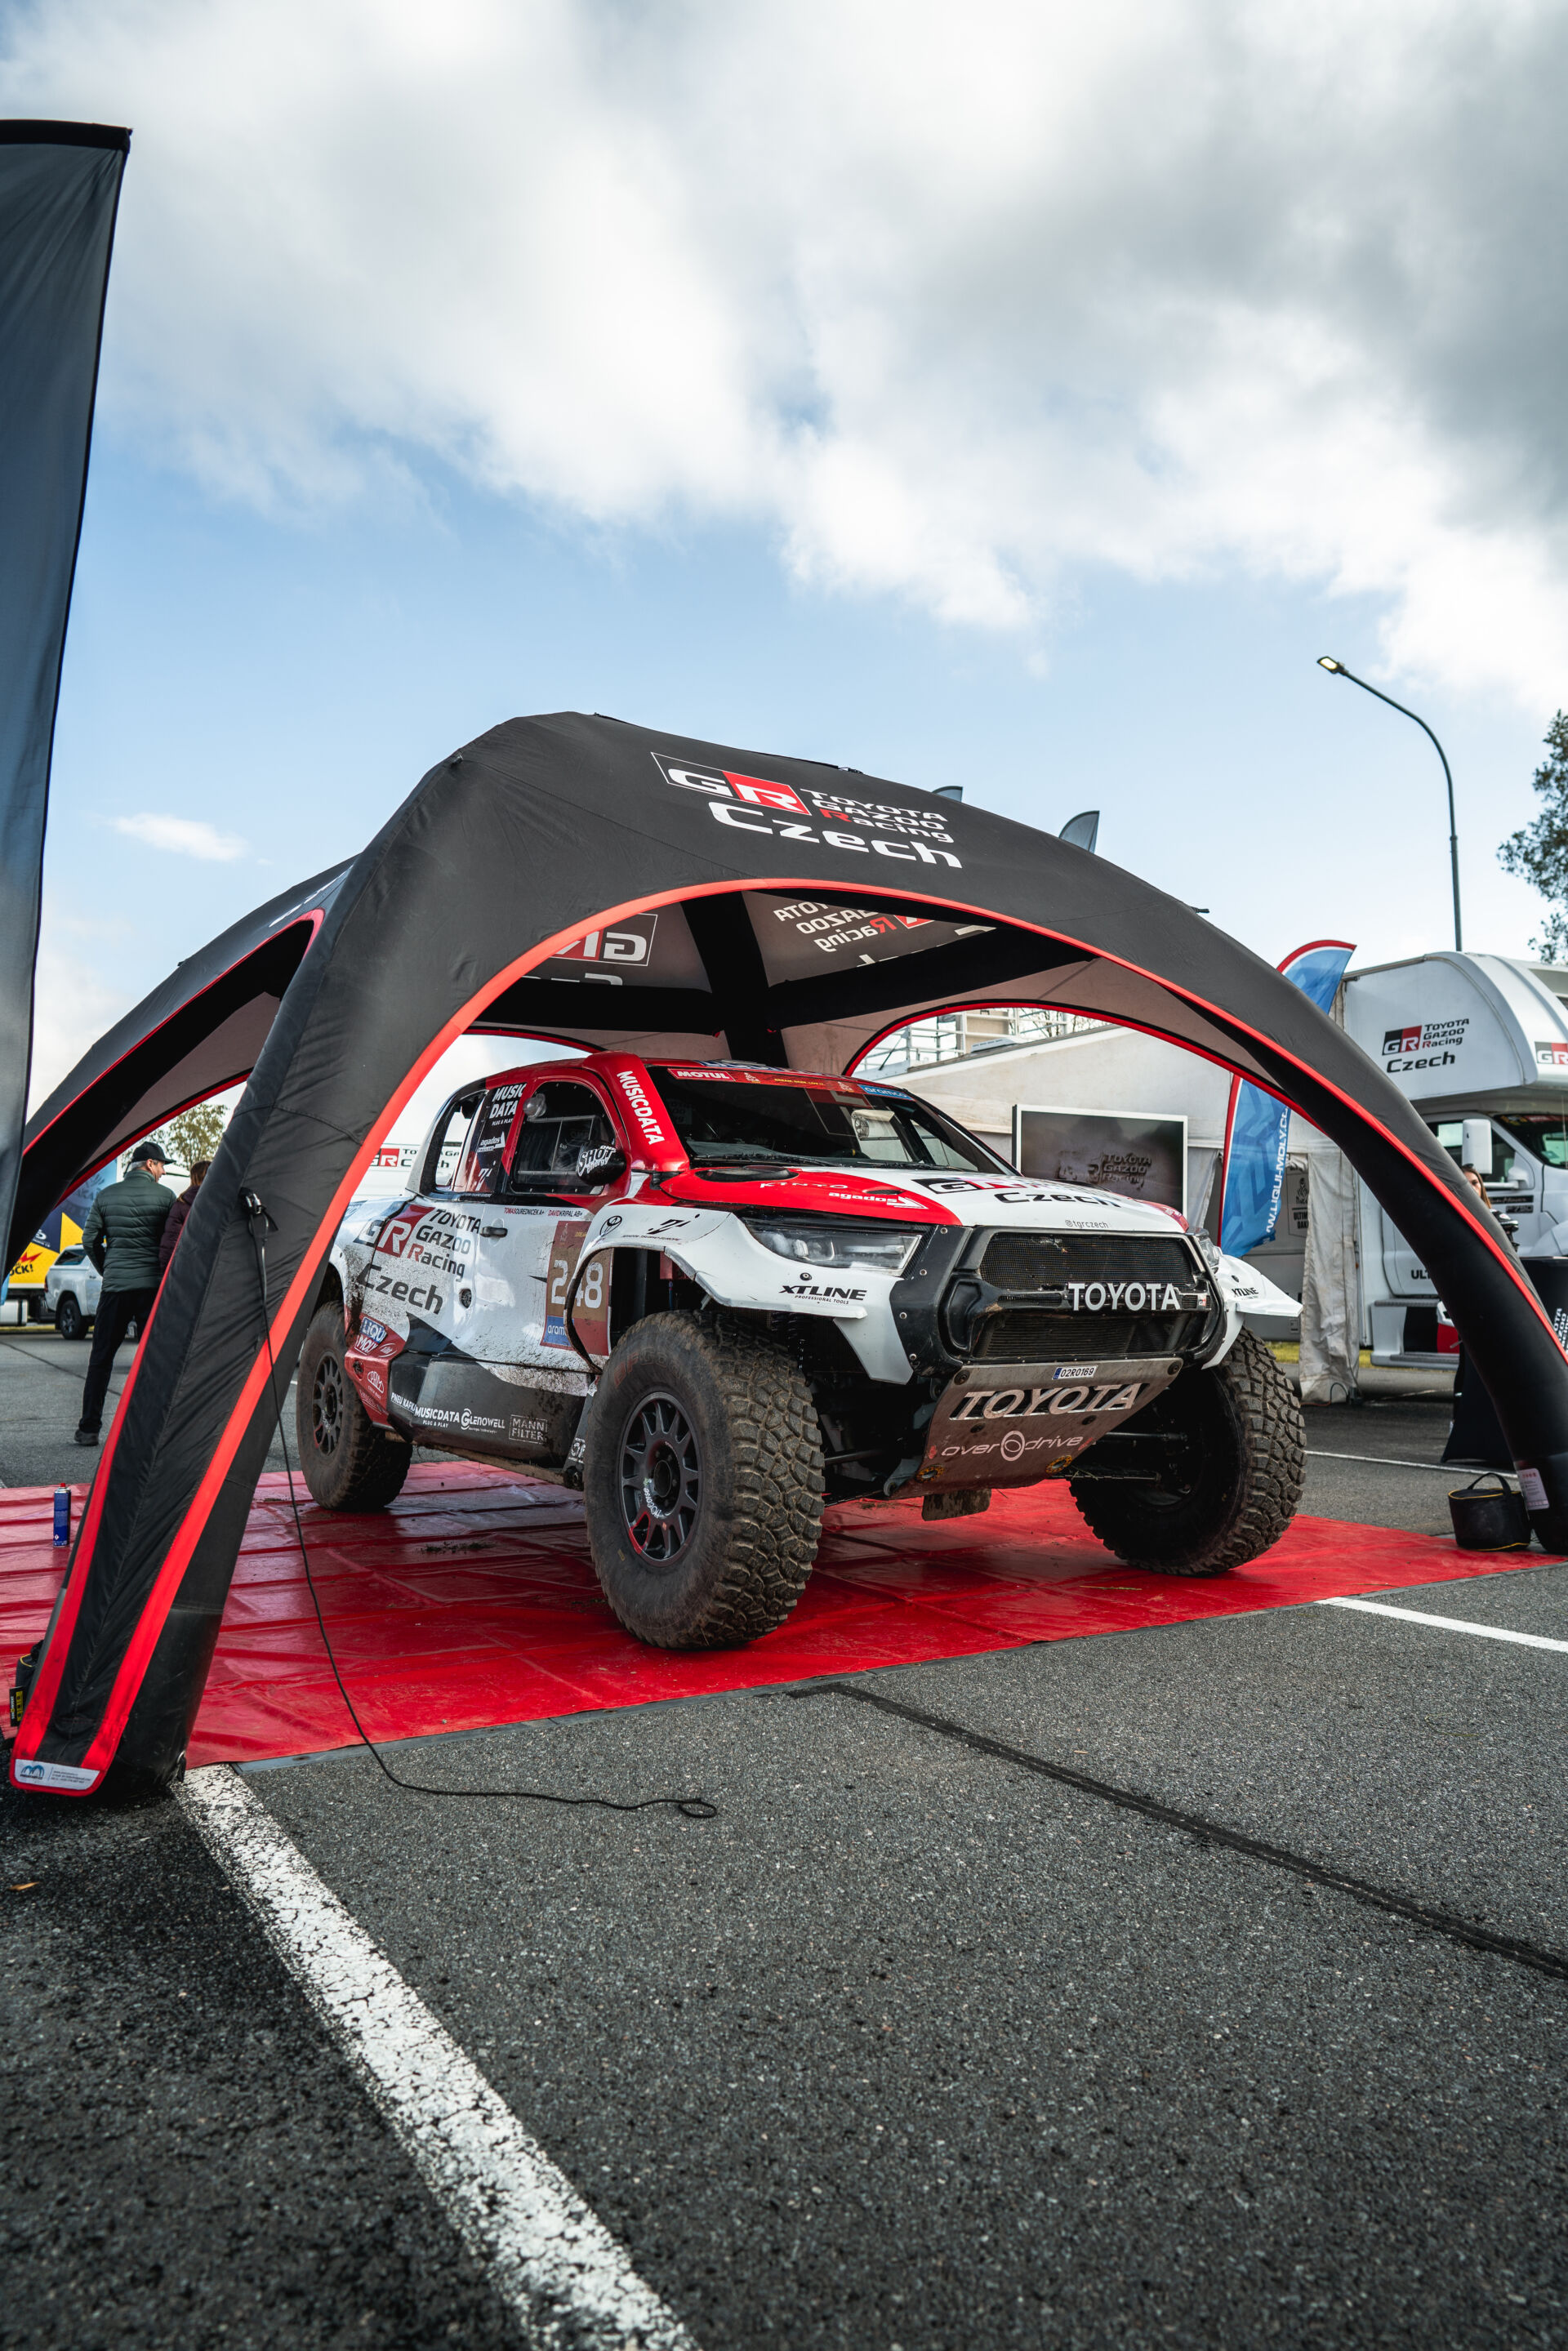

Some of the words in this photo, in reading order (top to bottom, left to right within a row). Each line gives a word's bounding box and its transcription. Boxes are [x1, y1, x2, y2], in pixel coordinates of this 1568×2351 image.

[668, 768, 804, 812] GR
[800, 788, 948, 822] TOYOTA
[812, 799, 944, 830] GAZOO
[708, 802, 963, 869] Czech
[819, 808, 955, 844] Racing
[1423, 1018, 1470, 1031] TOYOTA
[1423, 1028, 1465, 1040] GAZOO
[1383, 1037, 1419, 1056] GR
[1422, 1036, 1463, 1049] Racing
[1387, 1051, 1456, 1073] Czech
[676, 1071, 728, 1080] MOTUL
[492, 1084, 527, 1102] MUSIC
[489, 1100, 519, 1120] DATA
[617, 1071, 665, 1145] MUSICDATA
[577, 1149, 615, 1176] SHOT
[1103, 1163, 1148, 1174] GAZOO
[828, 1192, 898, 1202] agados
[994, 1191, 1121, 1208] Czech
[429, 1209, 482, 1234] TOYOTA
[1065, 1219, 1109, 1229] @tgrczech
[416, 1225, 471, 1254] GAZOO
[408, 1243, 466, 1282] Racing
[357, 1263, 443, 1315] Czech
[778, 1285, 868, 1301] XTLINE
[1068, 1283, 1181, 1311] TOYOTA
[1060, 1367, 1095, 1378] 02R0169
[391, 1391, 403, 1404] PNEU
[950, 1383, 1144, 1420] TOYOTA
[415, 1407, 460, 1423] MUSICDATA
[512, 1418, 545, 1430] MANN
[511, 1427, 544, 1440] FILTER
